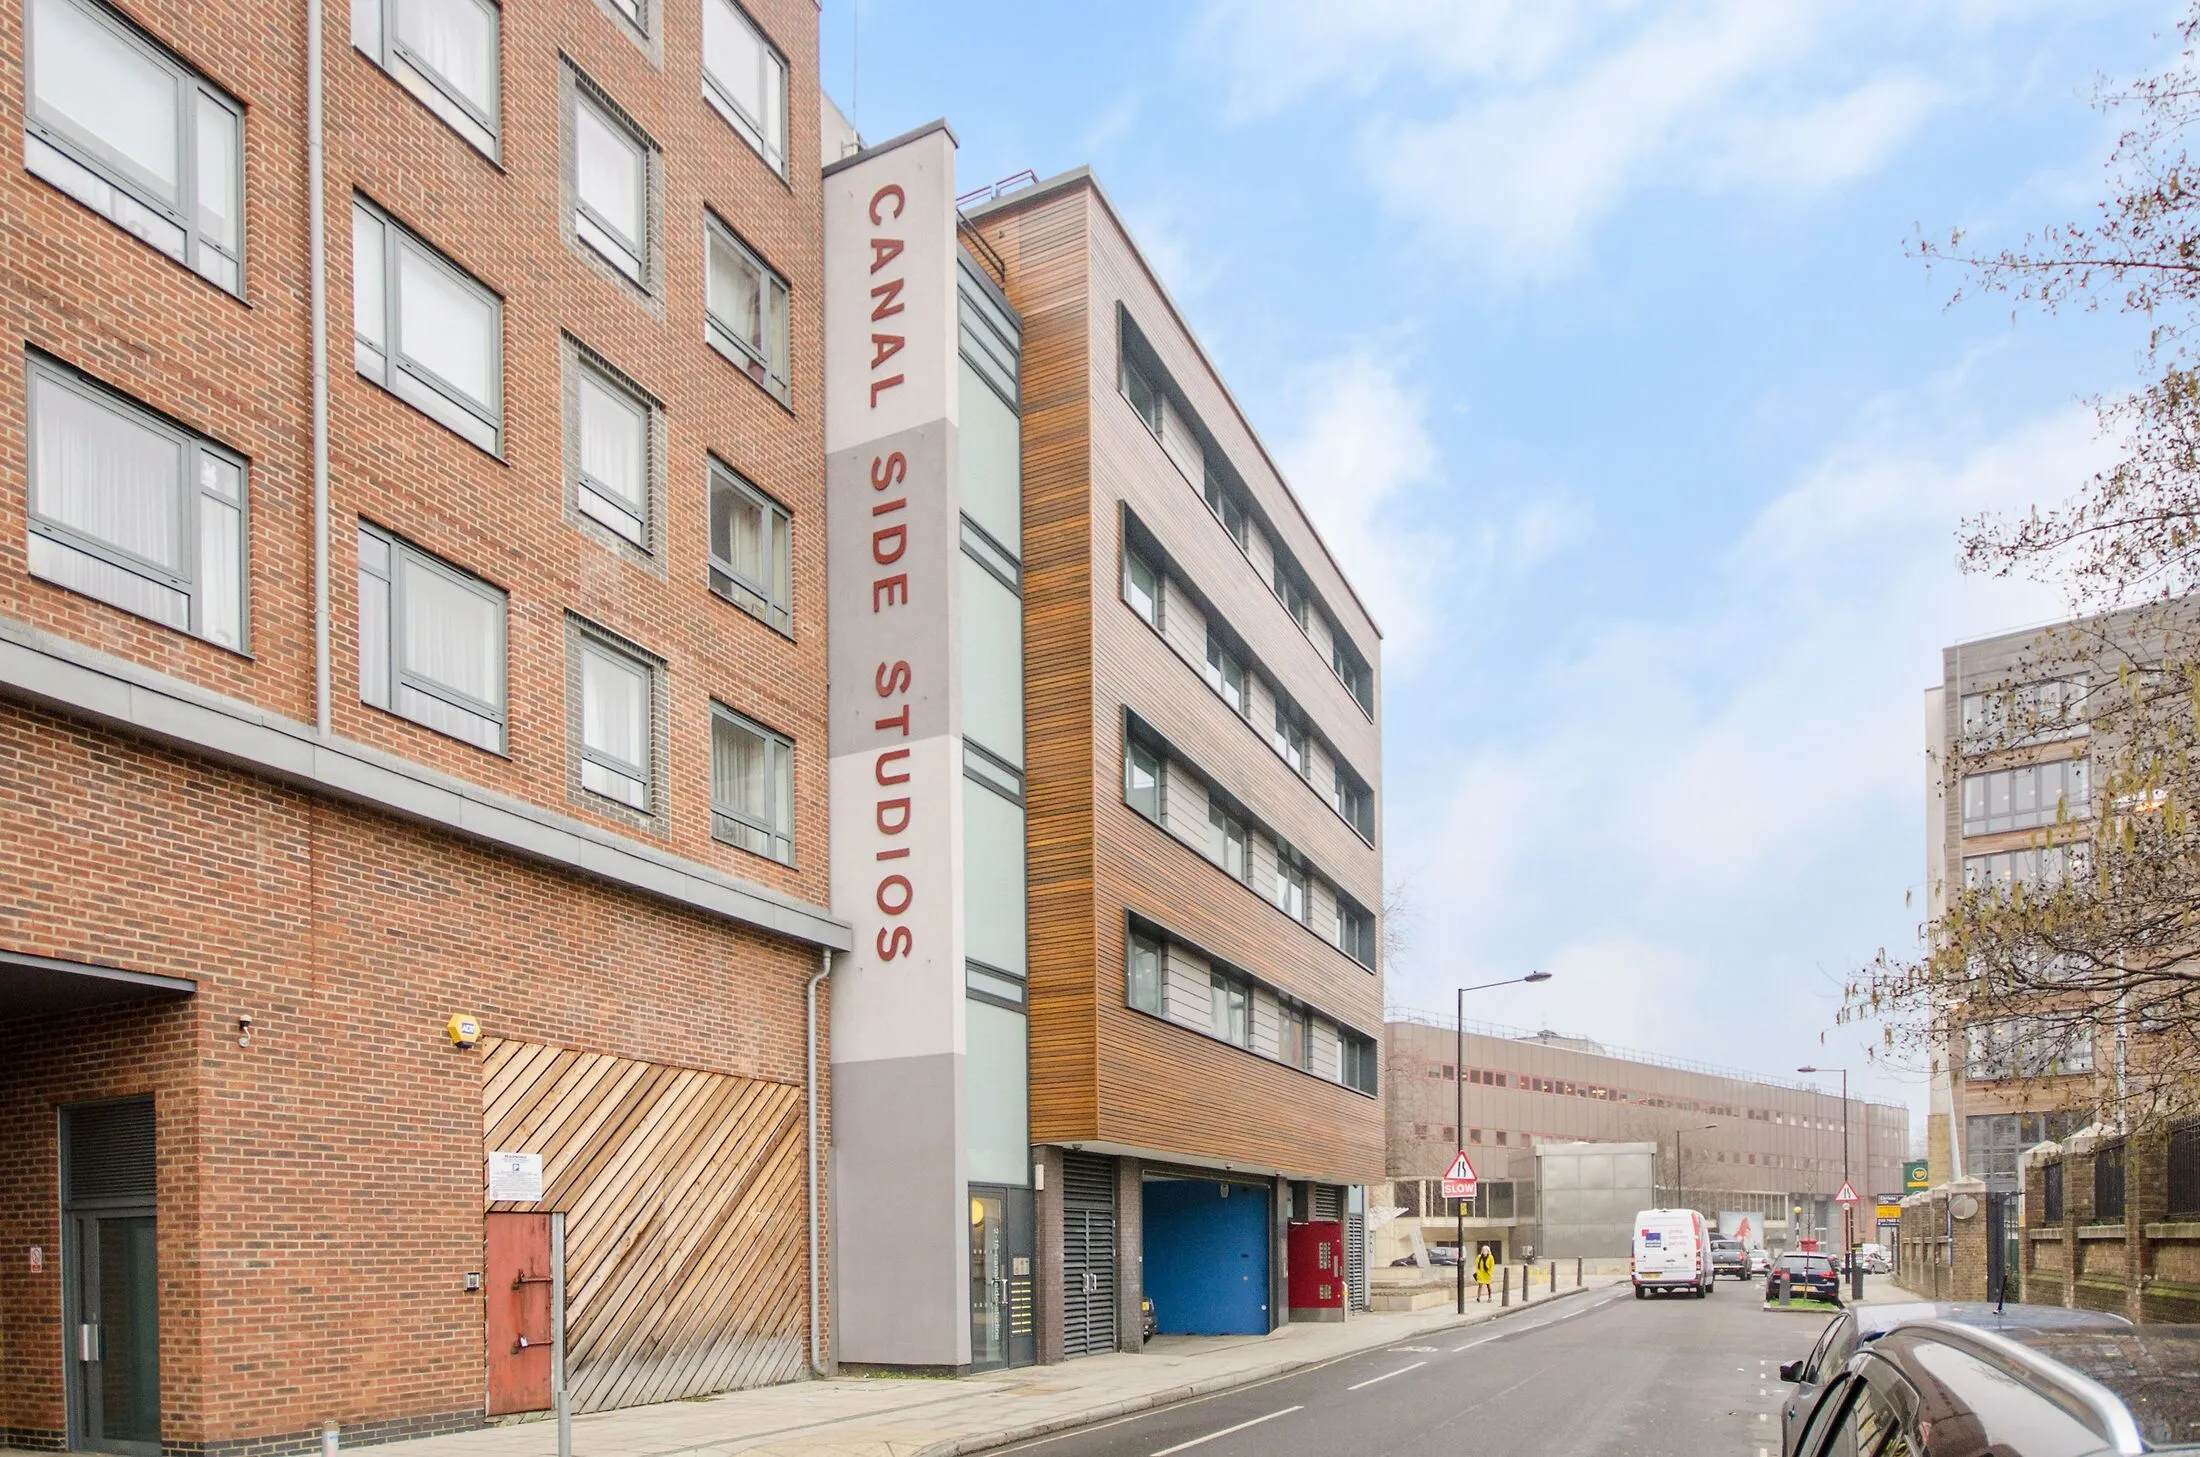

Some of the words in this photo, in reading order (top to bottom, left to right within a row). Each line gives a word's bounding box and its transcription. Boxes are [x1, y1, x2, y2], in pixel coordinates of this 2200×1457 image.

[870, 185, 905, 409] CANAL
[871, 450, 909, 615] SIDE
[875, 660, 913, 962] STUDIOS
[1445, 1184, 1474, 1193] SLOW
